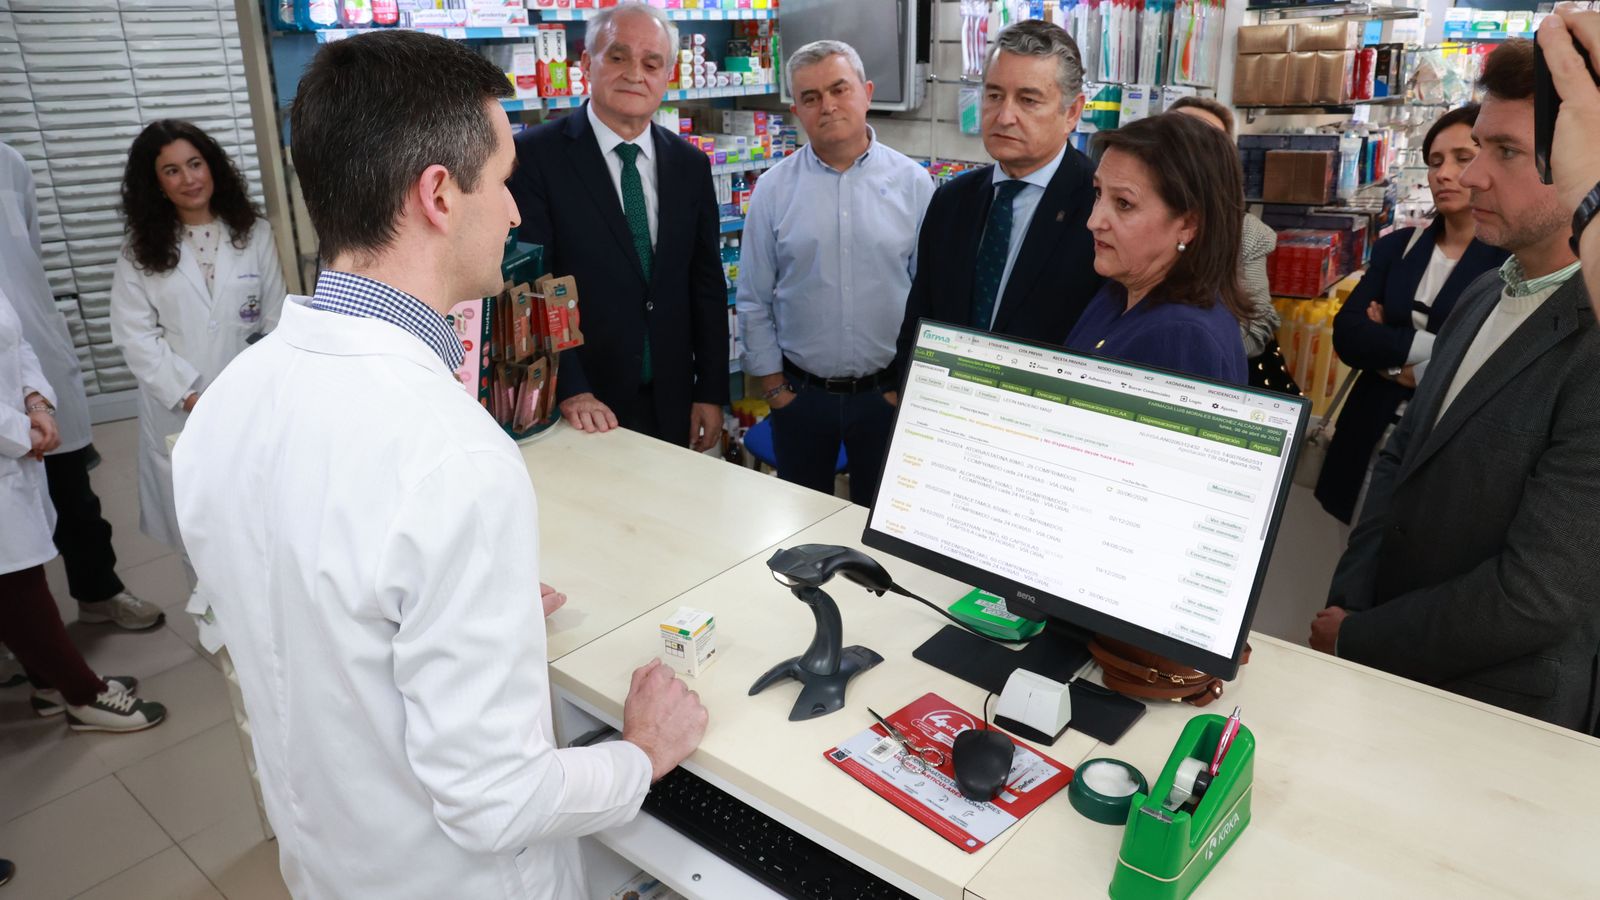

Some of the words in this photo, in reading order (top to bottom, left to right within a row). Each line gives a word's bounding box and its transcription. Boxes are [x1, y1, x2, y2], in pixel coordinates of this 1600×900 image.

[923, 328, 951, 343] farma
[1208, 389, 1240, 399] INCIDENCIAS
[1186, 410, 1211, 418] MORALES
[1212, 416, 1237, 424] SANCHEZ
[1202, 430, 1240, 445] Configuración
[1252, 443, 1271, 452] Ayuda
[1016, 591, 1036, 604] BenQ
[929, 714, 953, 728] 4
[920, 770, 964, 798] ARTICULARES
[1218, 812, 1240, 845] KRKA
